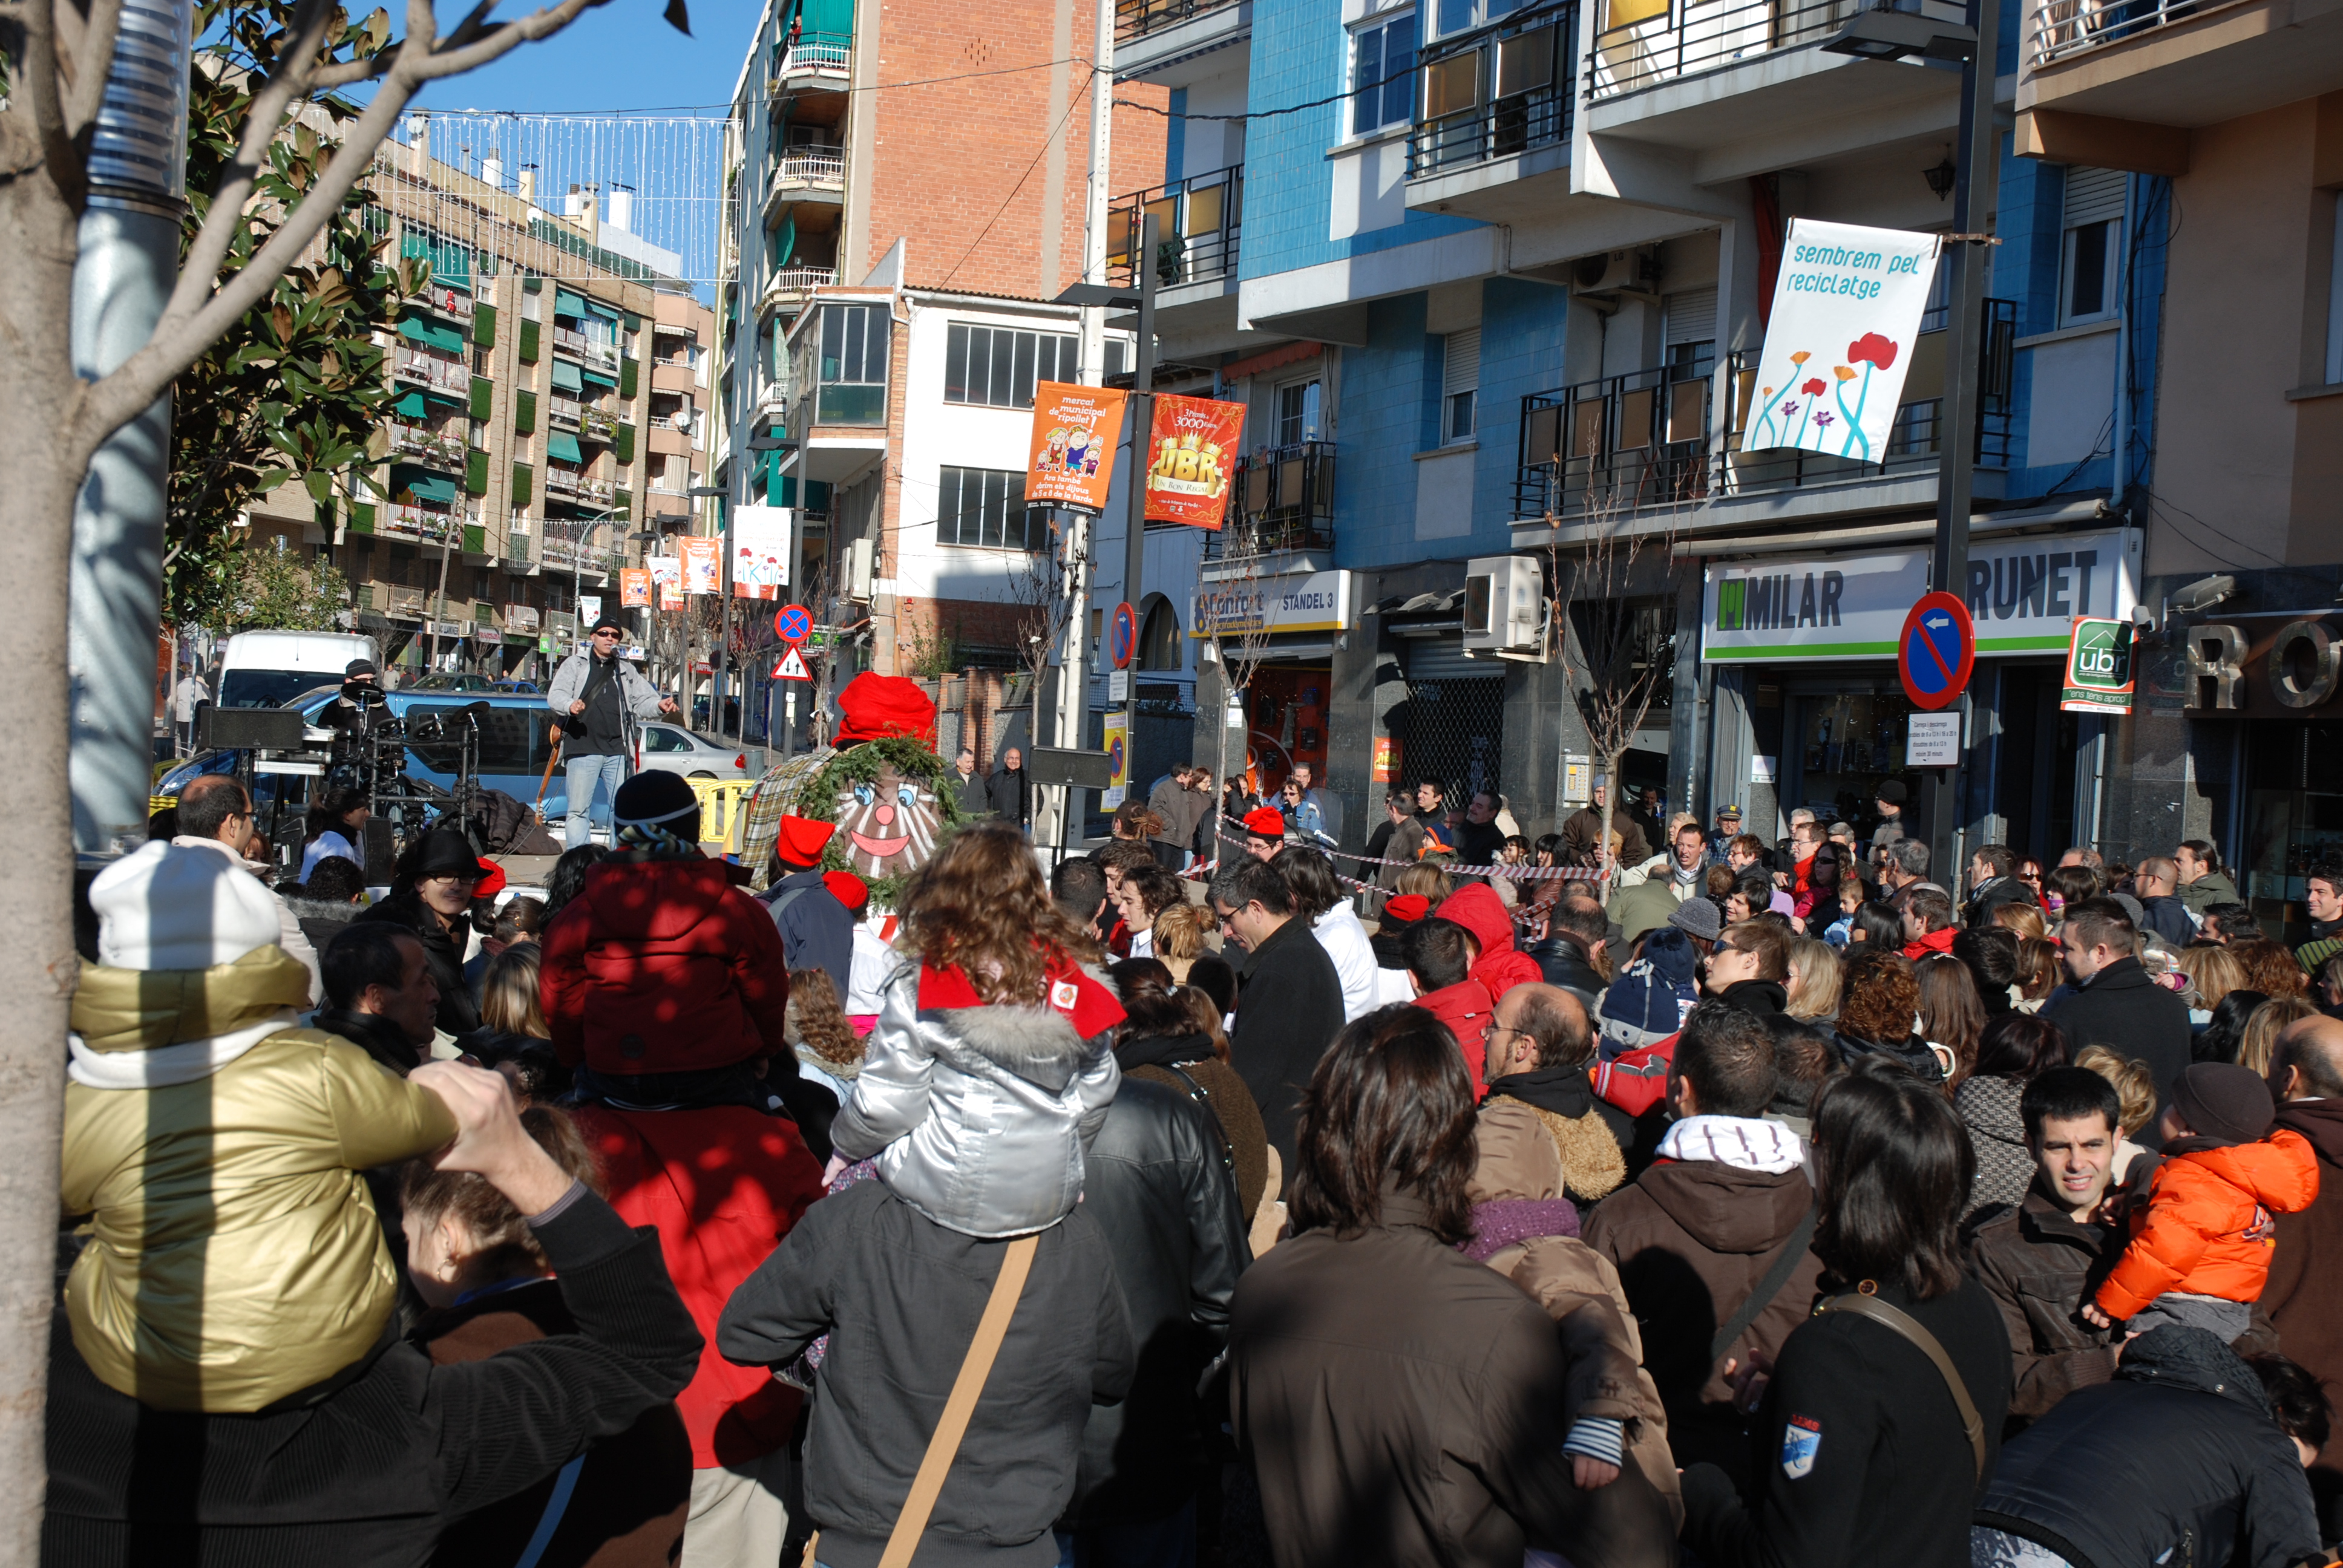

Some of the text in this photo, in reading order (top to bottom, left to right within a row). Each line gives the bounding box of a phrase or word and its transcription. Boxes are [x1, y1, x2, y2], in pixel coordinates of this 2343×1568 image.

[1614, 252, 1624, 261] LG
[1794, 244, 1919, 274] sembrem pel
[1787, 272, 1881, 300] reciclatge
[1062, 397, 1095, 406] mercat
[1049, 407, 1060, 416] de
[1057, 413, 1090, 423] ripollet
[1060, 405, 1106, 417] municipal
[1184, 408, 1190, 417] 3
[1175, 416, 1204, 429] 3000
[1158, 448, 1217, 482] UBR
[1057, 475, 1081, 485] també
[1066, 484, 1089, 494] dijous
[1072, 493, 1093, 503] tarda
[1967, 550, 2097, 621] RUNET
[1283, 593, 1324, 611] STANDEL
[1327, 592, 1334, 609] 3
[1745, 570, 1844, 630] MILAR
[2079, 648, 2126, 673] ubr
[2086, 691, 2103, 701] tens
[1314, 829, 1339, 846] Pioneer
